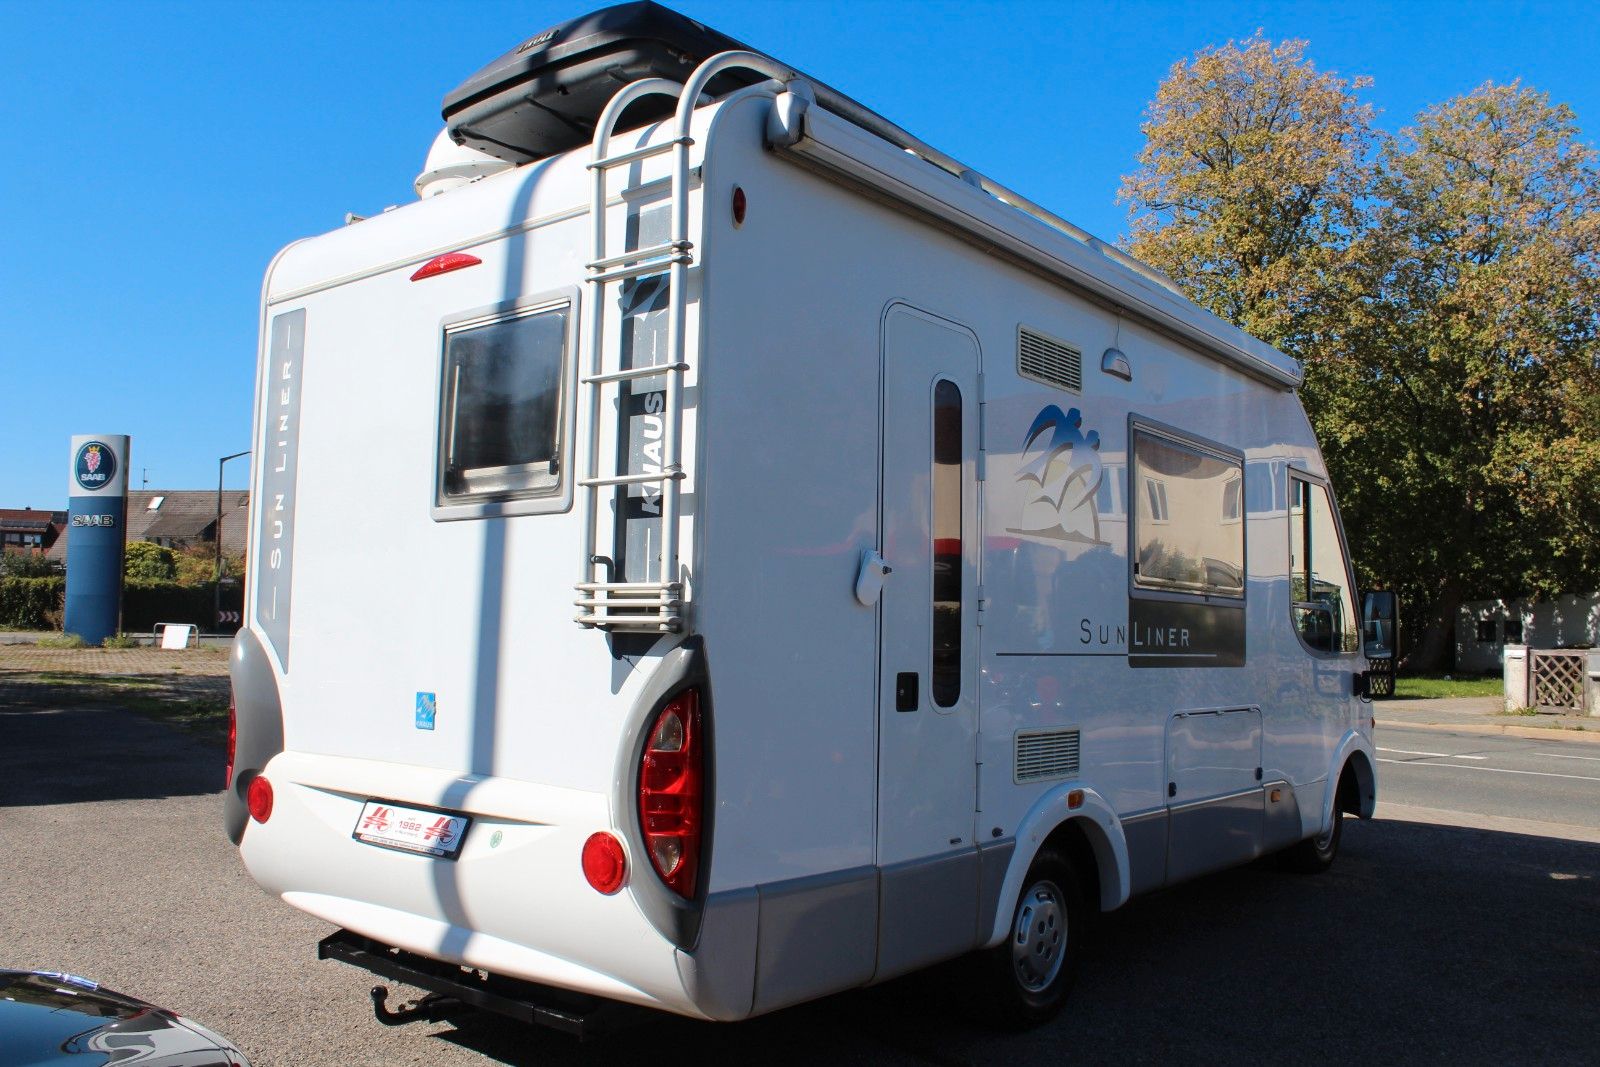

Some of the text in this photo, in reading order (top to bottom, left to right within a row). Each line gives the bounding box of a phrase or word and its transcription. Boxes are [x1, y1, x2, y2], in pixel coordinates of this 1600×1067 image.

[641, 392, 664, 515] KNAUS
[270, 360, 291, 569] SUN LINER
[81, 473, 106, 481] SAAB
[72, 515, 113, 527] SAAB
[399, 820, 422, 832] 1982
